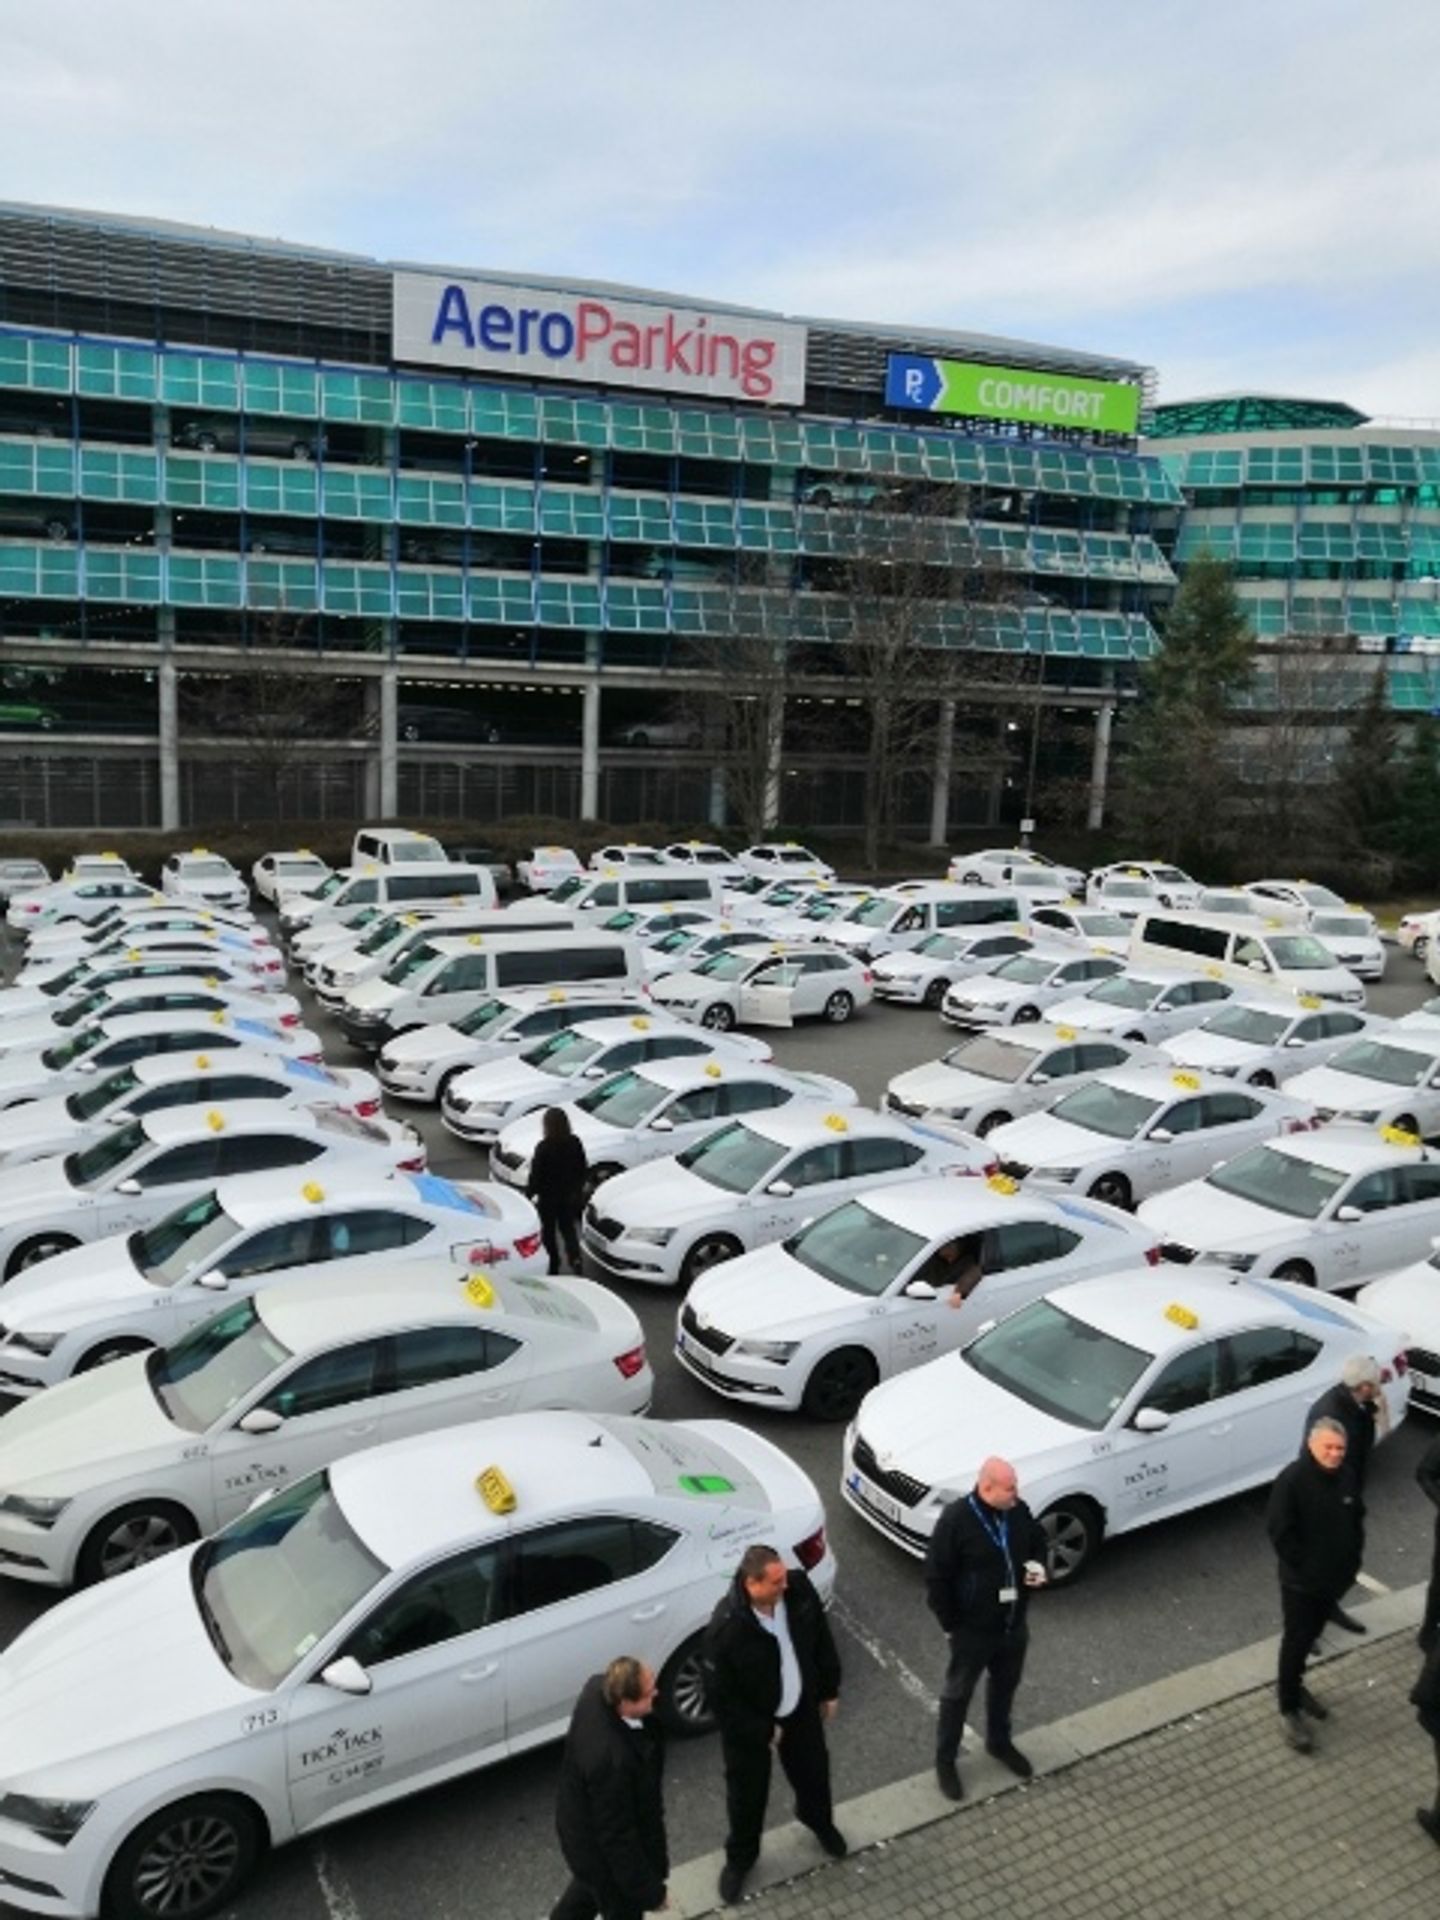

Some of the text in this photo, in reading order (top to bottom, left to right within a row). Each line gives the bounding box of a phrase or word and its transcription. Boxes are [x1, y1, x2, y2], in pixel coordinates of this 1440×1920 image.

[430, 284, 775, 398] AeroParking
[977, 378, 1106, 420] COMFORT
[244, 1709, 279, 1731] 713
[300, 1724, 383, 1767] TICK TACK
